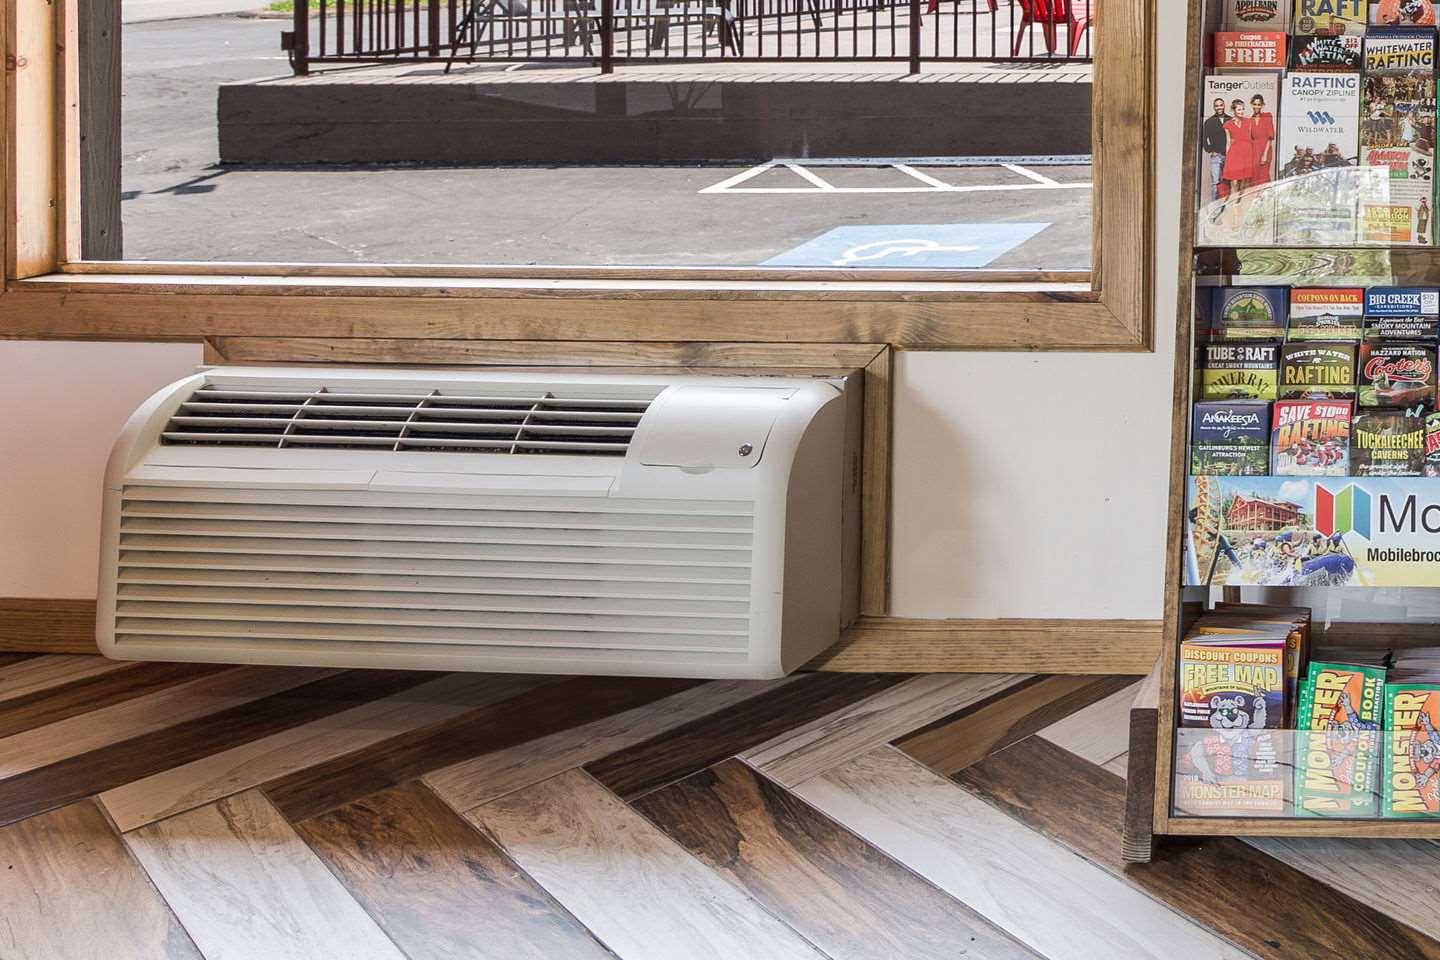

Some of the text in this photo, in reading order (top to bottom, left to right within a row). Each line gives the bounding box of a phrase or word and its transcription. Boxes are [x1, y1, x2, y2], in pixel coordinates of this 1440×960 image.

[1366, 42, 1432, 54] WHITEWATER
[1225, 49, 1277, 64] FREE
[1367, 53, 1432, 68] RAFTING
[1292, 77, 1356, 88] RAFTING
[1297, 294, 1357, 302] COUPONS ON BACK
[1369, 294, 1420, 305] BIG CREEK
[1207, 347, 1275, 360] TUBE RAFT
[1285, 350, 1351, 361] WHITE WATER
[1285, 365, 1350, 384] RAFTING
[1203, 410, 1259, 425] ANAKEESTA
[1279, 406, 1311, 425] SAVE
[1356, 430, 1424, 449] TUCKALEECHEE
[1371, 450, 1408, 460] CAVERNS
[1184, 649, 1278, 663] DISCOUNT COUPONS
[1184, 664, 1278, 692] FREE MAP
[1362, 677, 1377, 720] BOOK
[1353, 732, 1369, 792] COUPON
